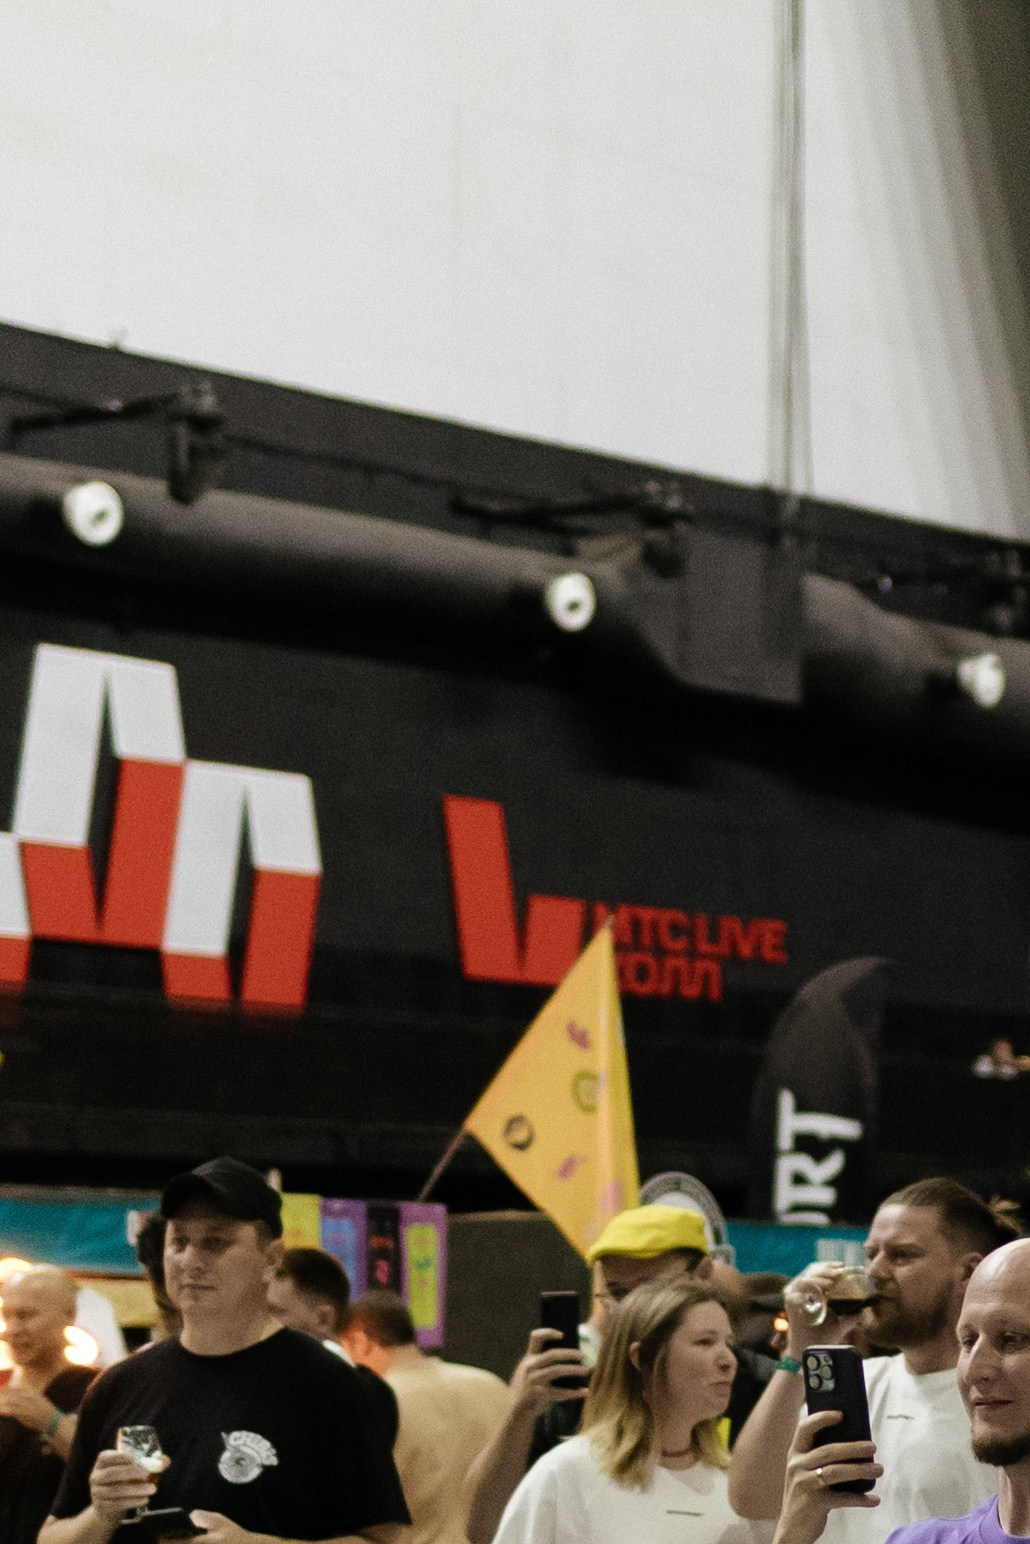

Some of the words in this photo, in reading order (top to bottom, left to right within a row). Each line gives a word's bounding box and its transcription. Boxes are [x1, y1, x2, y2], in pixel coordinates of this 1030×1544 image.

[694, 912, 788, 964] LIVE
[616, 951, 722, 1001] ОЛЛ
[775, 1088, 862, 1225] RT
